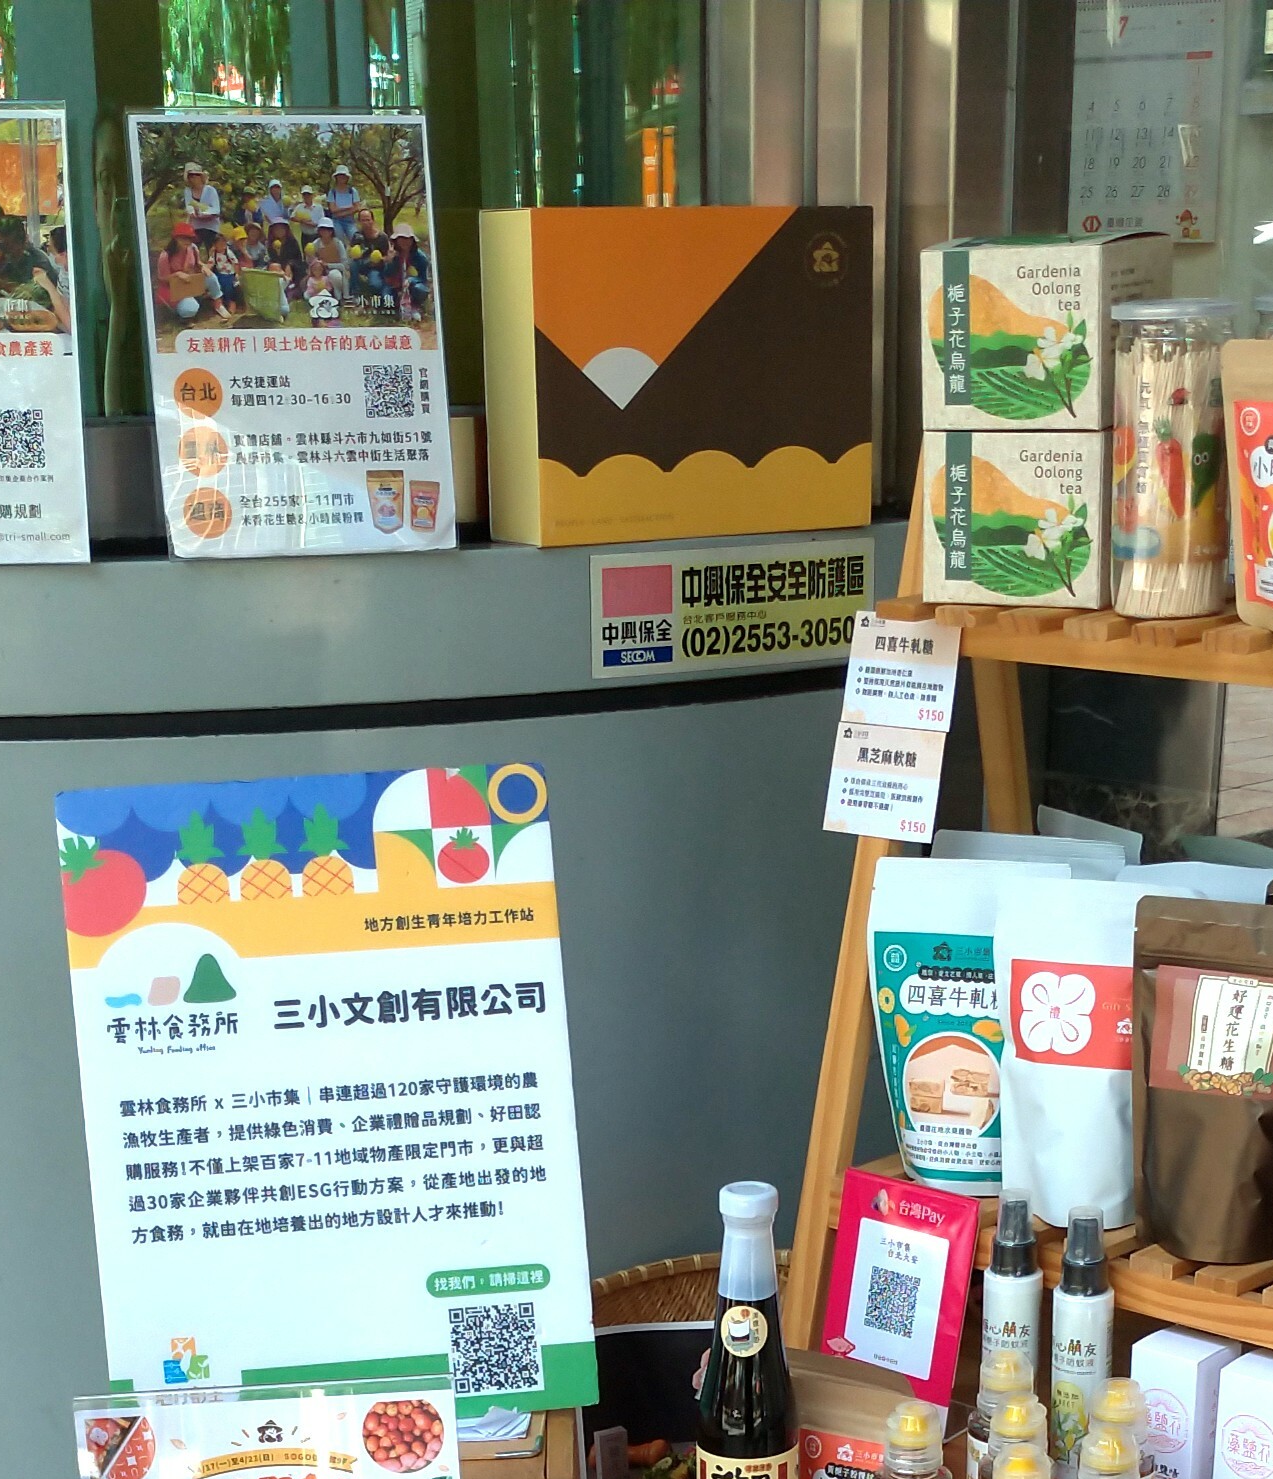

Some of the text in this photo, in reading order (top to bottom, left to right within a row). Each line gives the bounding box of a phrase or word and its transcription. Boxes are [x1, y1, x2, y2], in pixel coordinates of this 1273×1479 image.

[1017, 264, 1081, 280] Gardenia
[1032, 281, 1081, 297] Oolong
[1058, 299, 1081, 312] tea
[180, 382, 217, 402] 台北
[229, 375, 291, 389] 大安捷運站
[1019, 449, 1084, 464] Gardenia
[1034, 465, 1083, 482] Oolong
[1059, 482, 1082, 496] tea
[681, 554, 865, 608] 中興保全安全防護區
[602, 619, 673, 646] 中興保全
[681, 615, 854, 659] (02)2553-3050
[874, 635, 934, 656] 四喜牛軋糖
[620, 650, 656, 664] SECOM
[918, 708, 944, 722] $150
[857, 746, 917, 769] 黑芝麻軟糖
[900, 819, 926, 834] $150
[364, 906, 535, 934] 地方創生青年培力工作站
[273, 981, 547, 1032] 三小文創有限公司
[106, 1010, 239, 1045] 雲林食務所
[1219, 989, 1248, 1071] 好運花生糖
[898, 1198, 946, 1228] 台灣Pay
